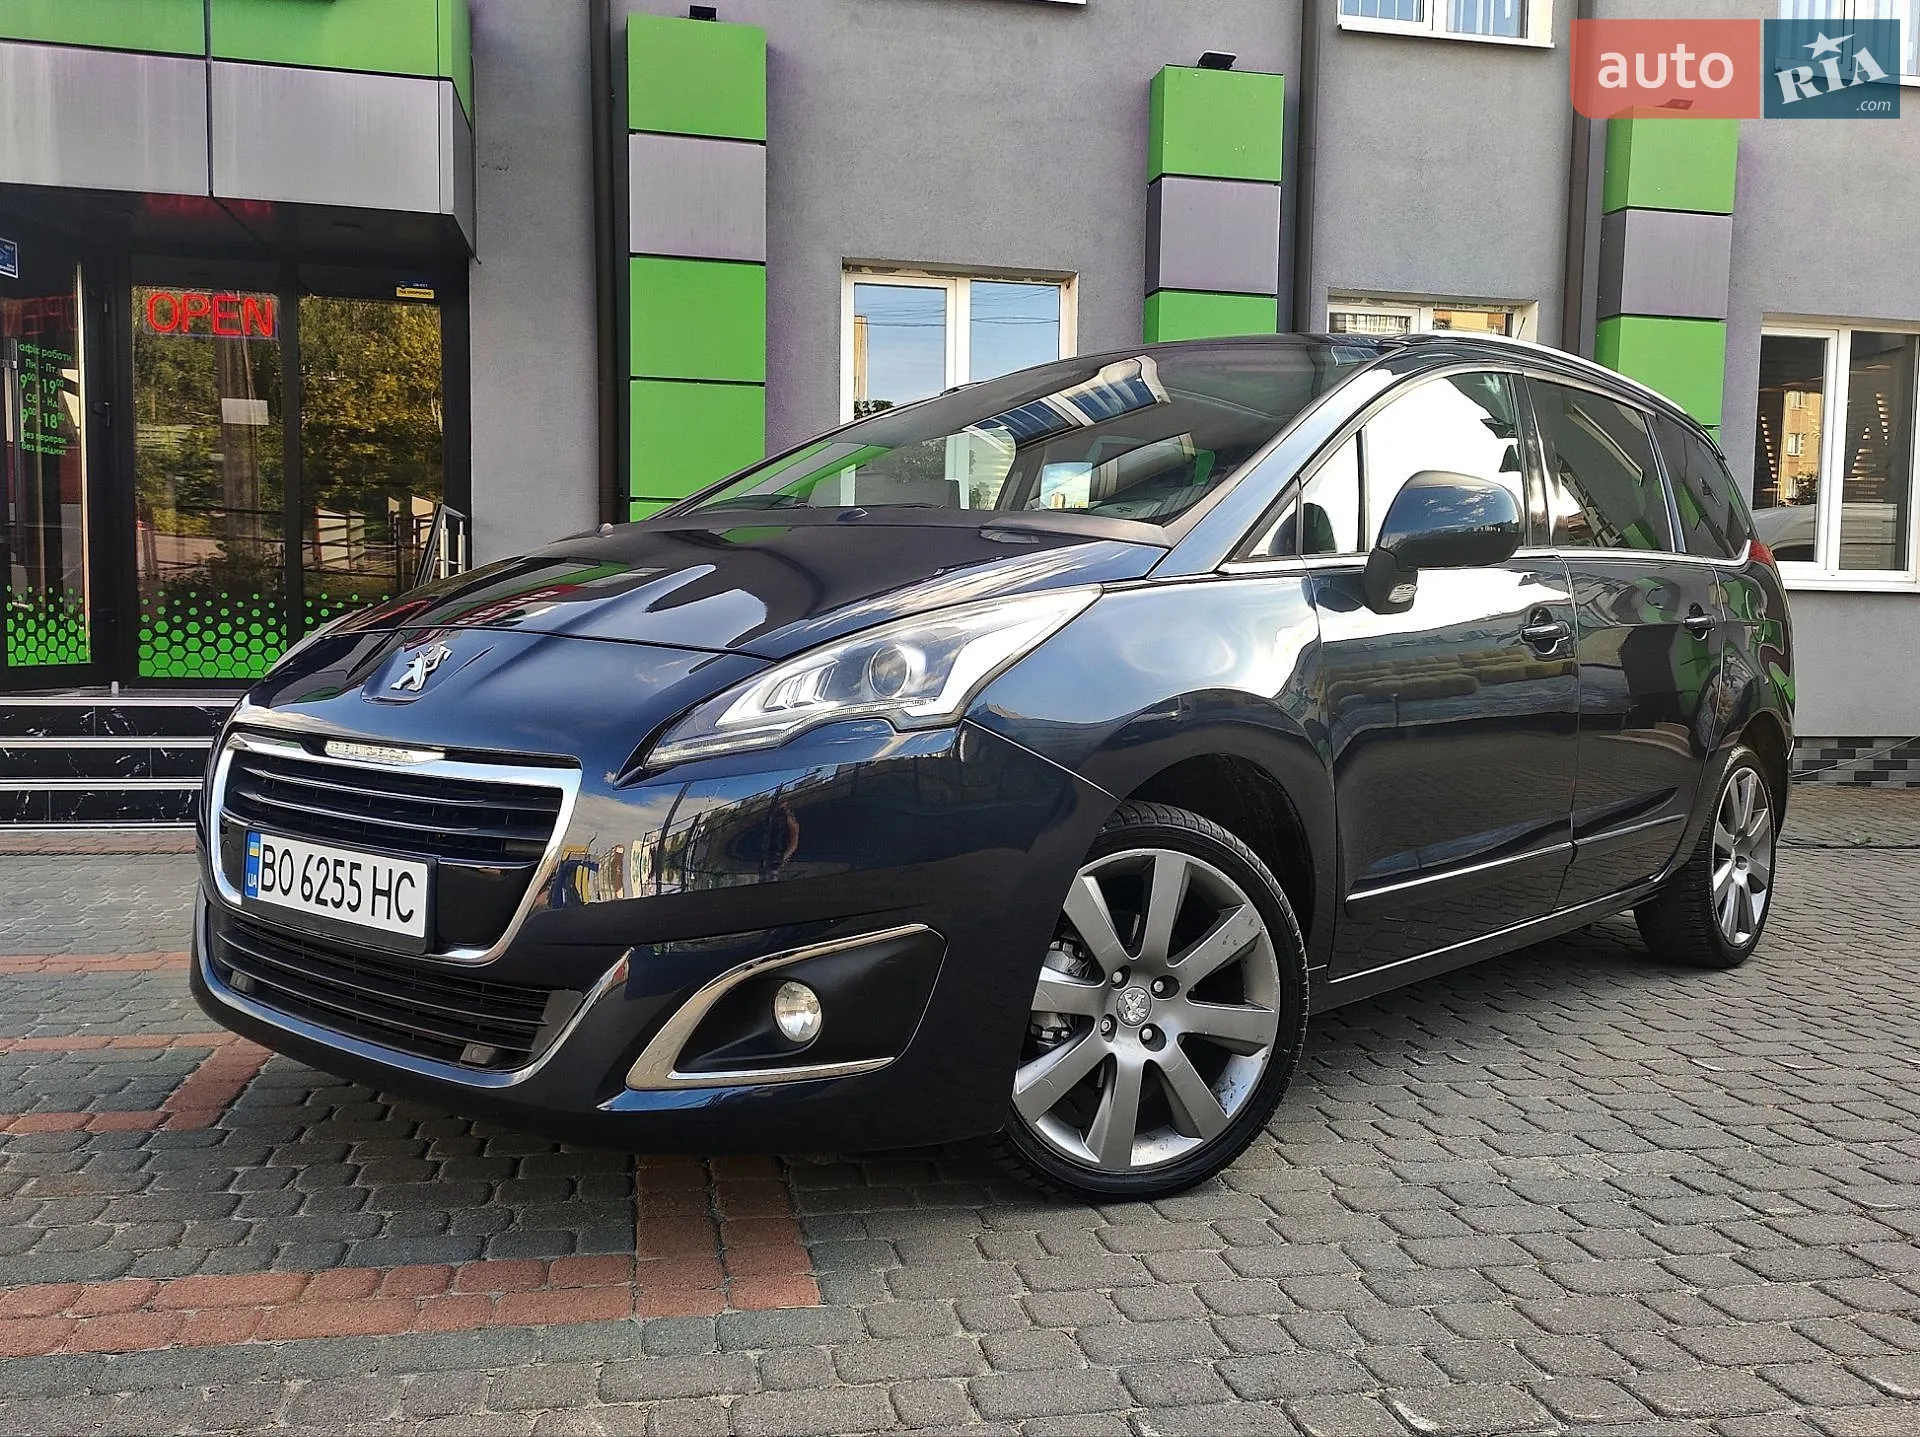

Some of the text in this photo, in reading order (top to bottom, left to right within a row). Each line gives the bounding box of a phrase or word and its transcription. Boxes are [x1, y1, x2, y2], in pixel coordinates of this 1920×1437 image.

[146, 291, 273, 337] OPEN
[41, 348, 72, 363] роботи
[247, 872, 257, 888] UA
[260, 843, 416, 923] BO 6255 HC
